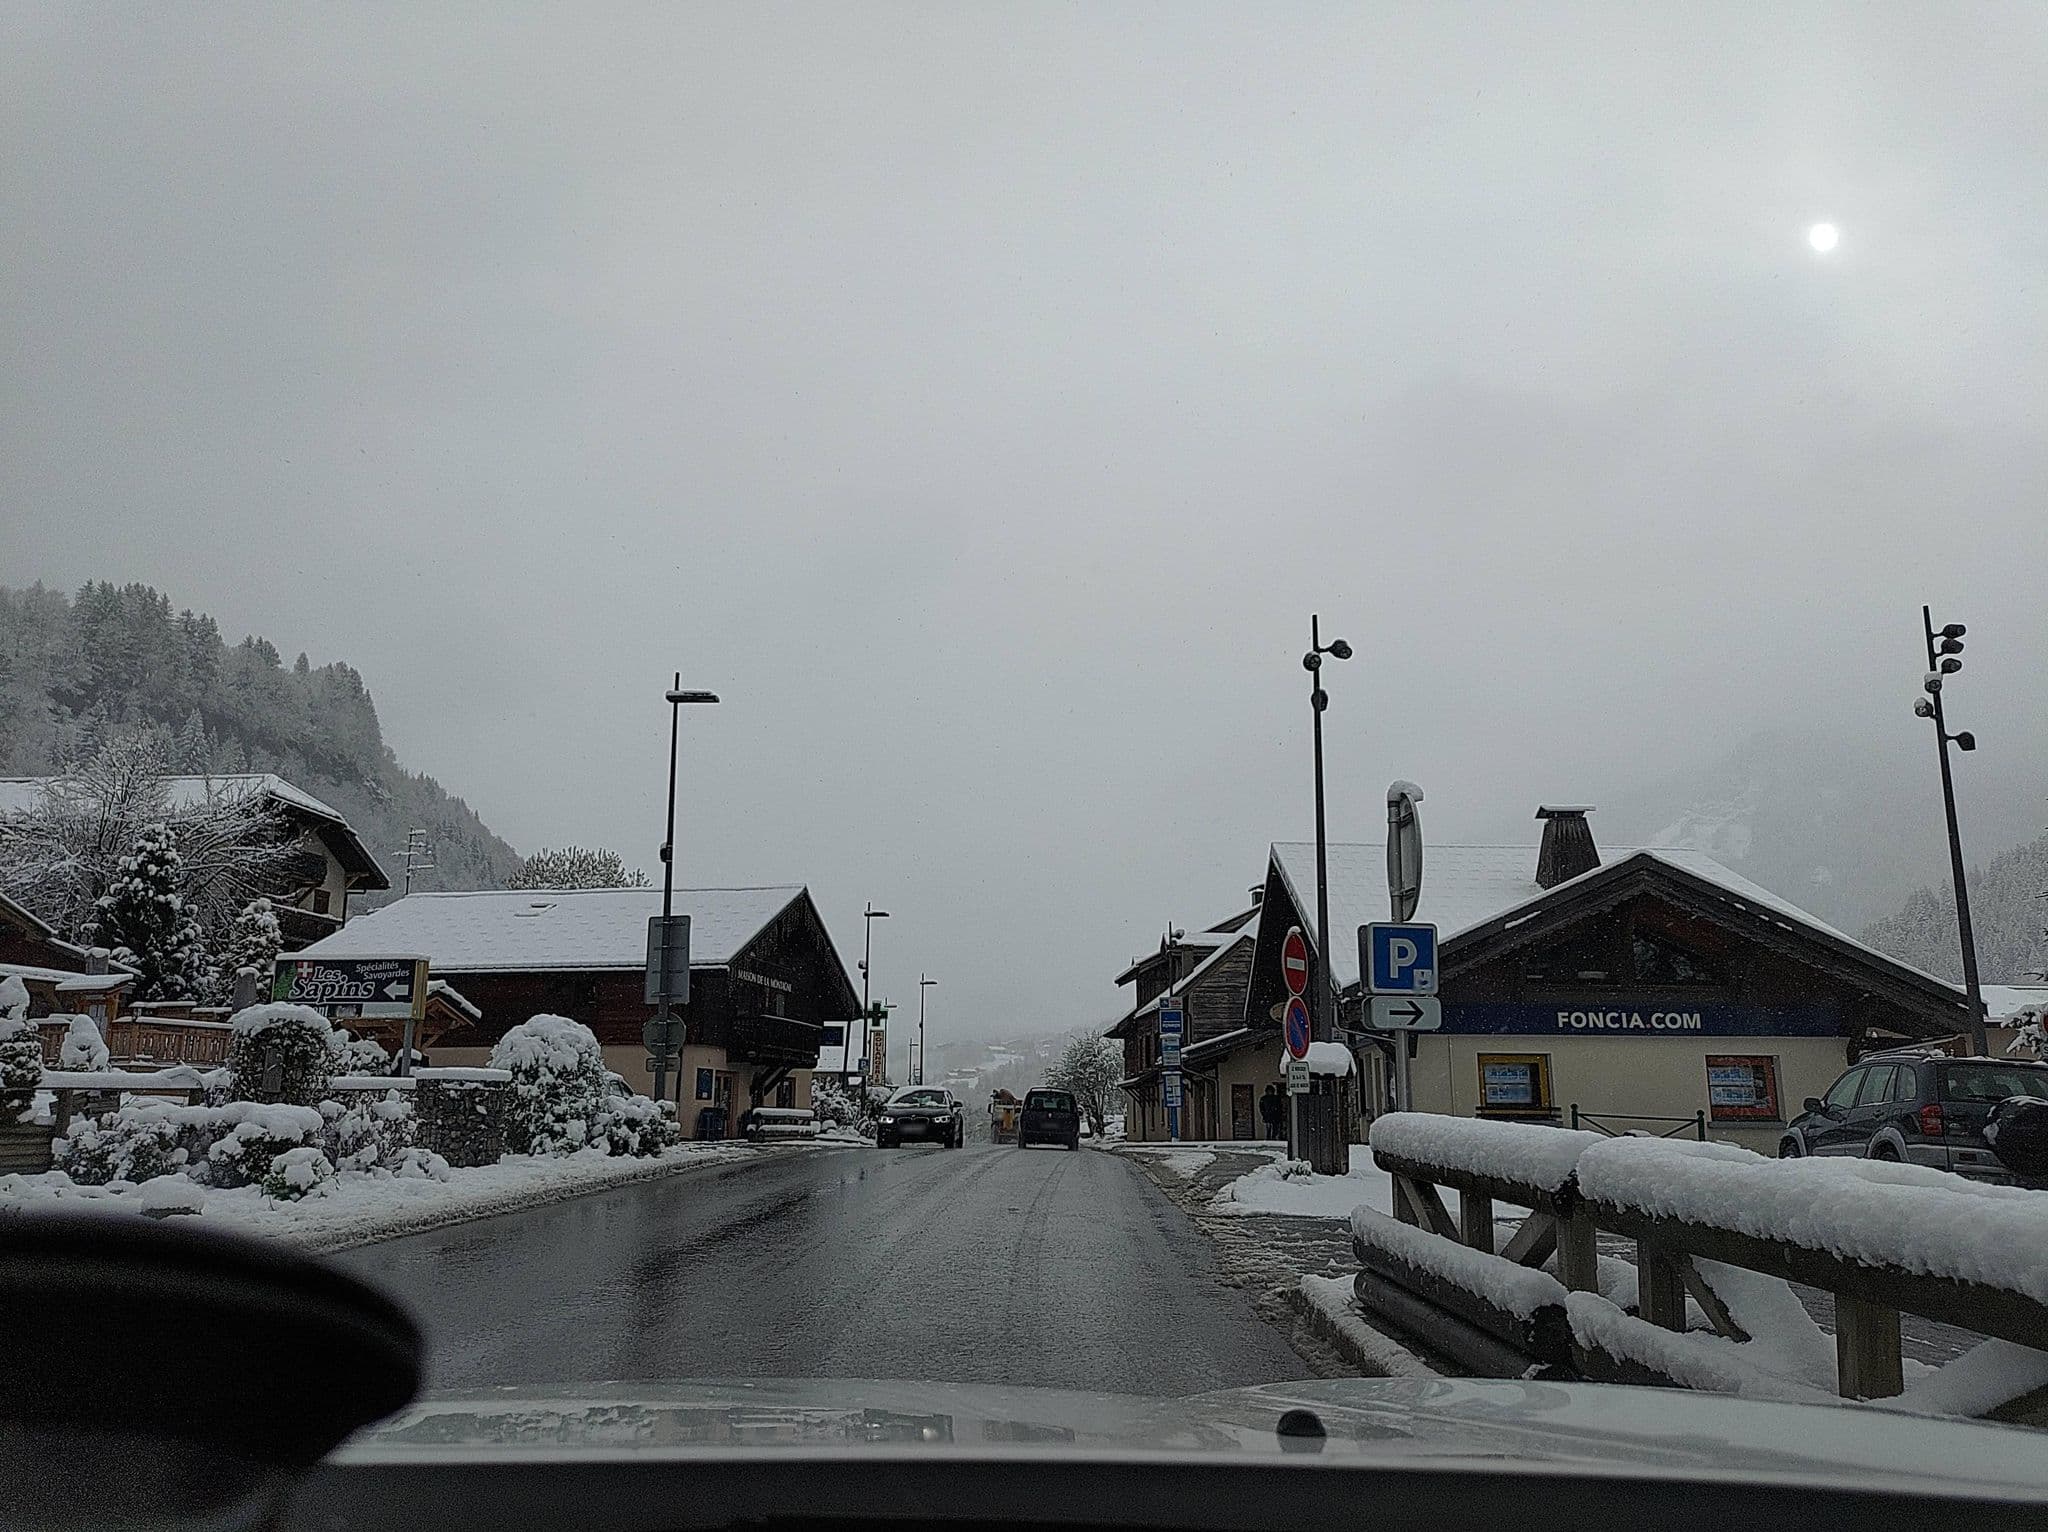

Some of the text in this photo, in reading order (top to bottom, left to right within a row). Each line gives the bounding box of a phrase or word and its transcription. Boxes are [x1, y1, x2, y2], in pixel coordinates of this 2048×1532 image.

[1390, 938, 1417, 978] P
[314, 966, 342, 981] Les
[356, 961, 399, 973] Spécialités
[363, 969, 410, 981] Savoyardes
[288, 974, 376, 1004] Sapins
[1557, 1011, 1701, 1029] FONCIA.COM
